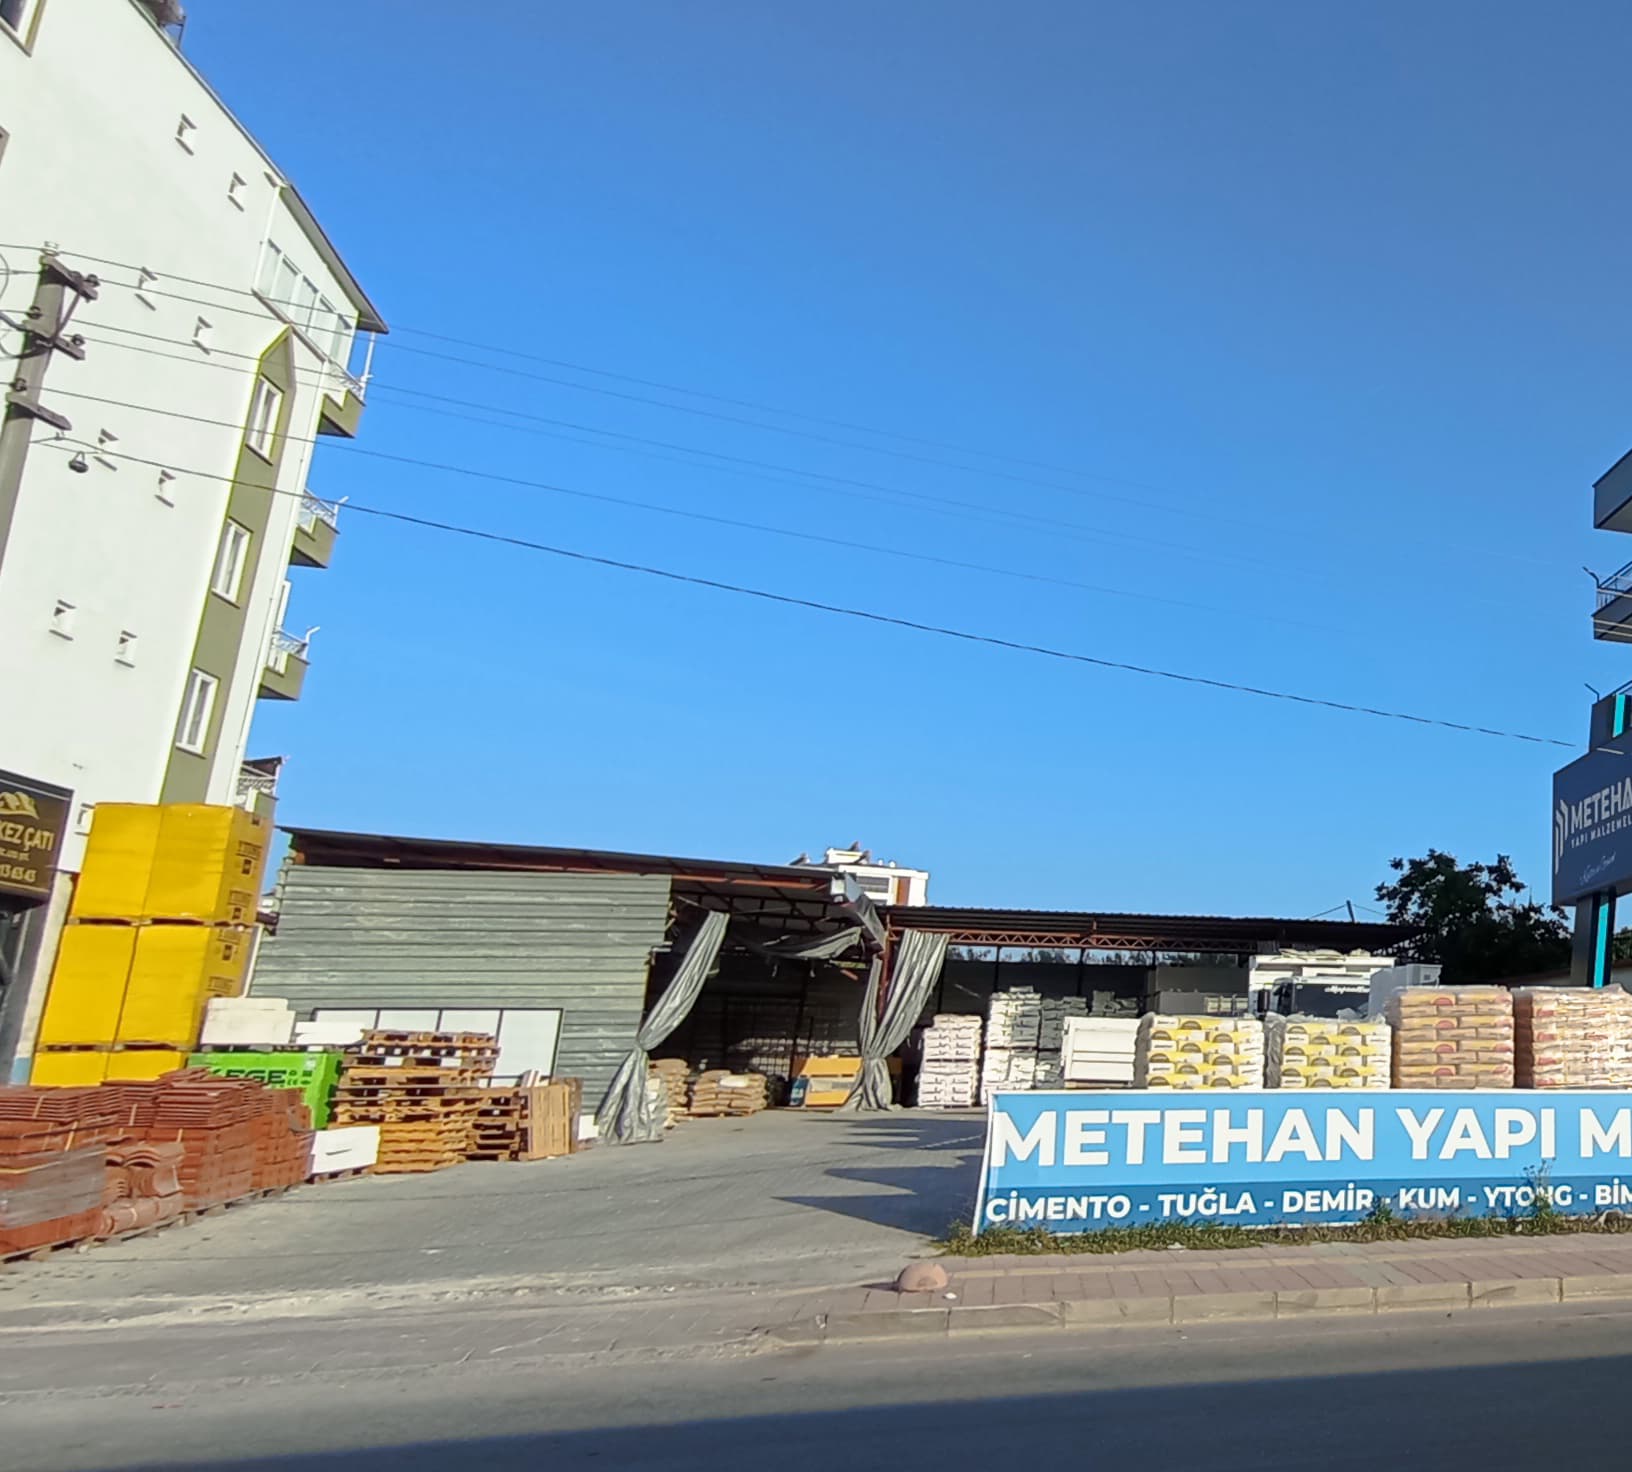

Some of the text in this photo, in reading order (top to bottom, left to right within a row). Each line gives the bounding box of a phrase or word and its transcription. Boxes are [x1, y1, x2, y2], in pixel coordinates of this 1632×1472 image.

[1571, 832, 1588, 848] YAPI
[991, 1108, 1374, 1167] METEHAN
[1396, 1107, 1556, 1160] YAPI
[1158, 1187, 1257, 1219] TUĞLA
[1282, 1182, 1374, 1213] DEMİR
[1400, 1187, 1460, 1210] KUM
